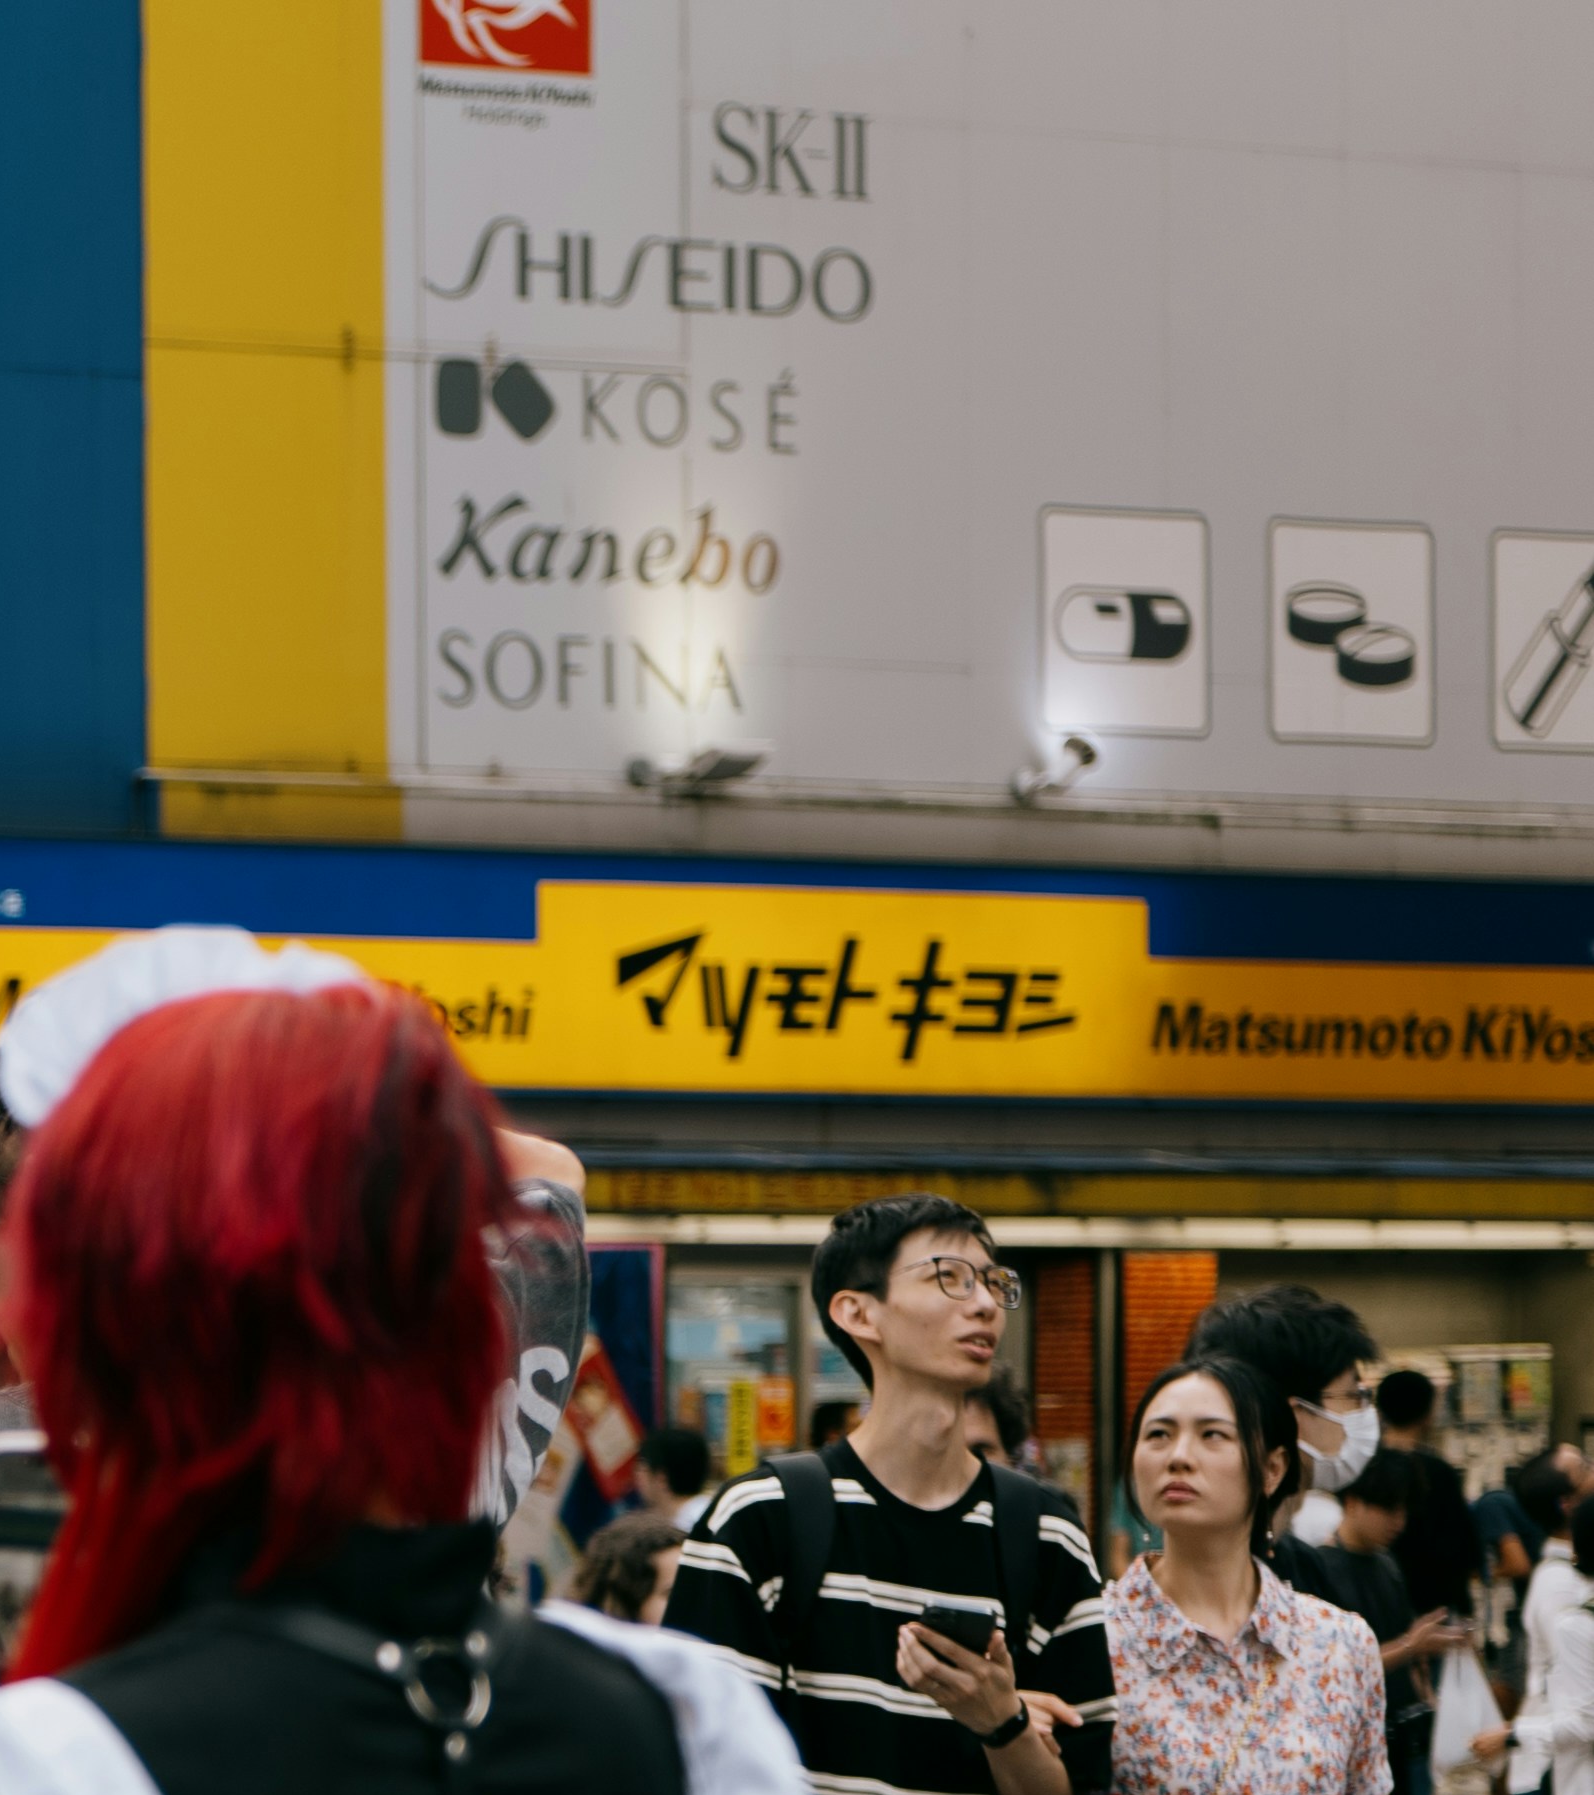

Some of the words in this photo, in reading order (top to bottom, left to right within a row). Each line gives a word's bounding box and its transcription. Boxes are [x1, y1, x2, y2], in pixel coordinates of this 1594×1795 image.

[714, 100, 872, 202] SK-II
[423, 214, 874, 324] SHISEIDO
[439, 493, 782, 597] Kanebo
[438, 627, 744, 714] SOFINA
[616, 926, 1078, 1063] マツモトキヨシ
[1153, 1000, 1454, 1062] Matsumoto
